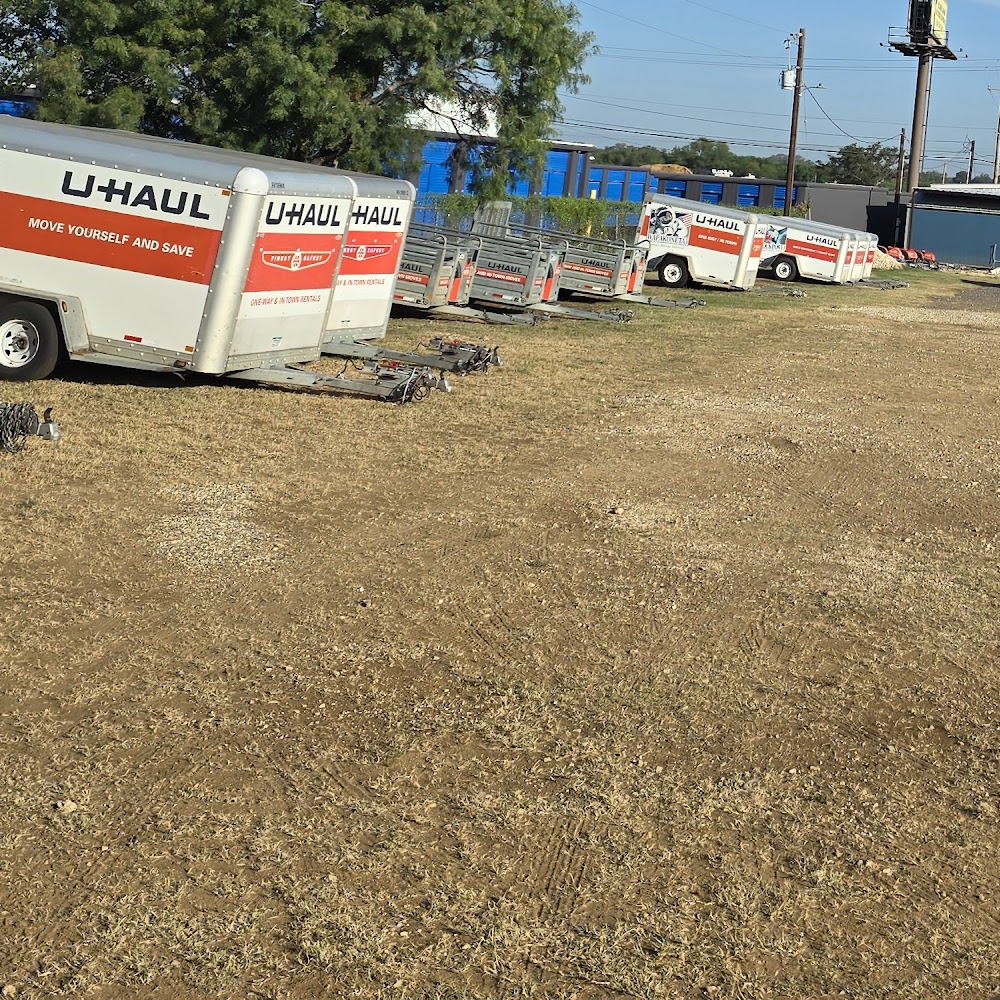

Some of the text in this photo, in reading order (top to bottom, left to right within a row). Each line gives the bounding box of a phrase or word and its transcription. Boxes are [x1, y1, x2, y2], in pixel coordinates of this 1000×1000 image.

[61, 171, 210, 220] U-HAUL
[265, 201, 340, 227] U-HAUL
[695, 214, 740, 232] U-HAUL
[28, 217, 195, 257] MOVE YOURSELF AND SAVE
[806, 234, 838, 247] U-HAUL
[487, 261, 522, 273] U-HAUL
[581, 259, 609, 269] U-HAUL
[250, 298, 273, 307] ONE-WAY
[300, 294, 321, 303] RENTALS
